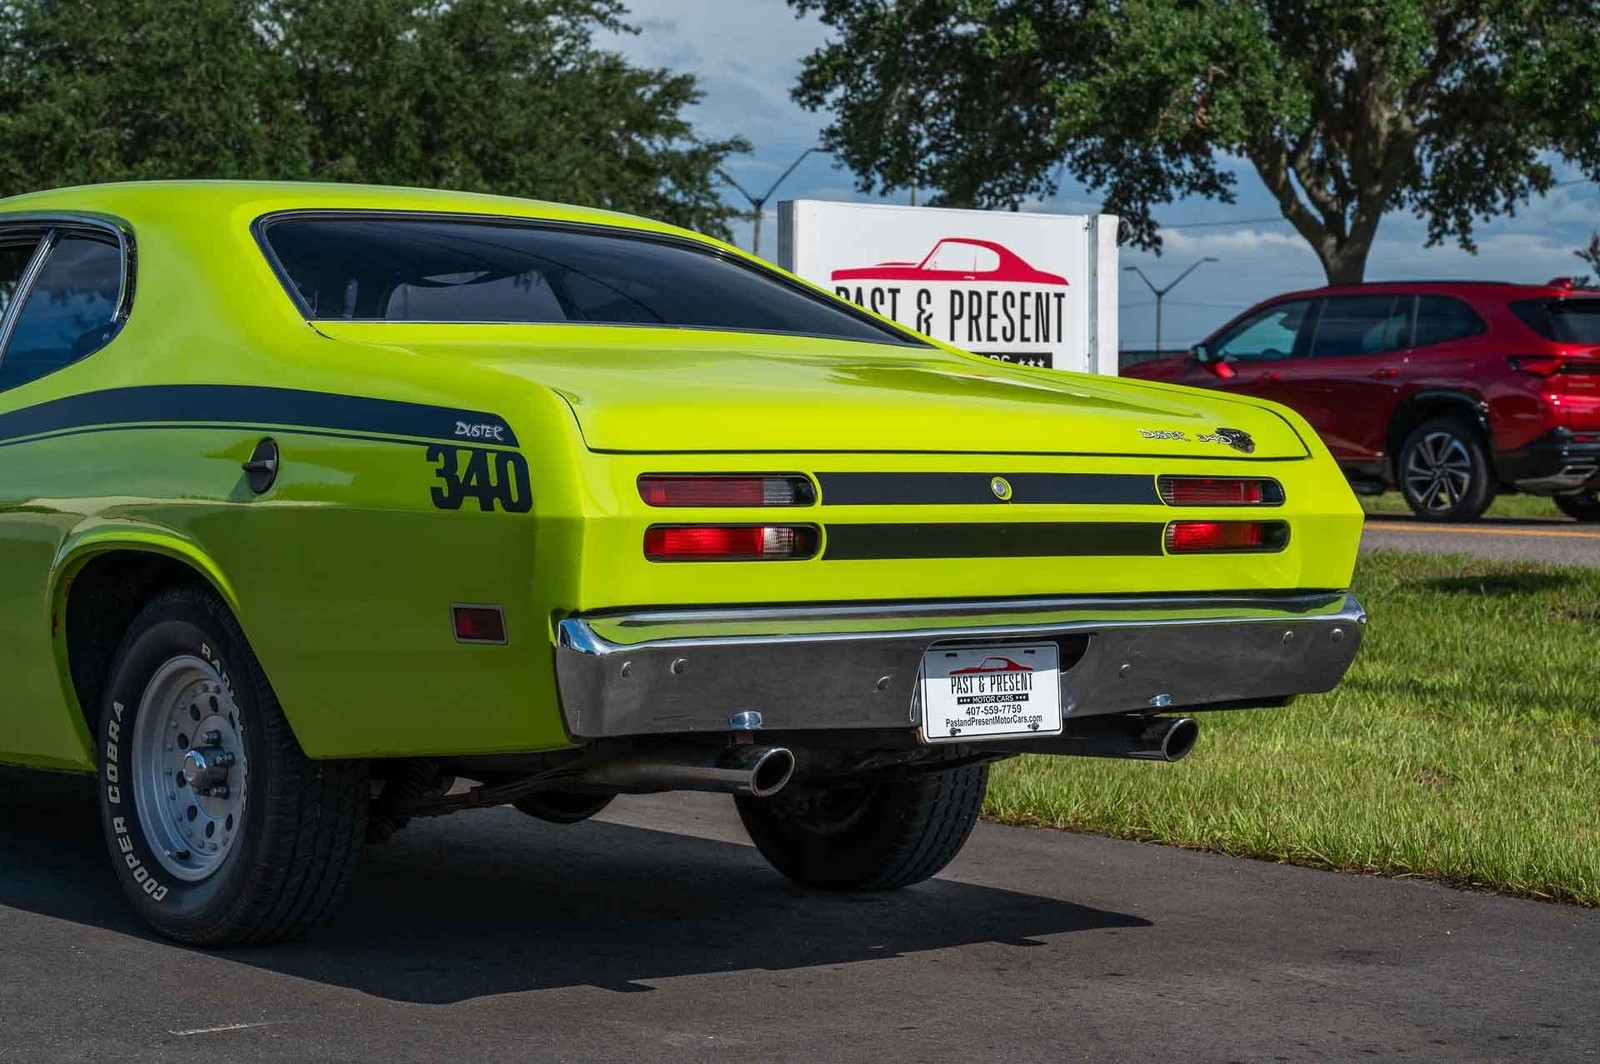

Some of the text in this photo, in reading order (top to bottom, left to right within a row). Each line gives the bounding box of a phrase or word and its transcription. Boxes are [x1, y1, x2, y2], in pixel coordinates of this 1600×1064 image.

[949, 289, 1066, 343] PRESENT
[455, 421, 503, 441] DUSTER
[426, 443, 533, 513] 340
[951, 673, 1033, 694] PAST & PRESENT
[972, 694, 1014, 704] MOTOR CARS
[965, 704, 1022, 716] 407-559-7759
[945, 715, 1043, 728] PastandPresentMotorCars.com
[106, 701, 169, 902] COOPER COBRA
